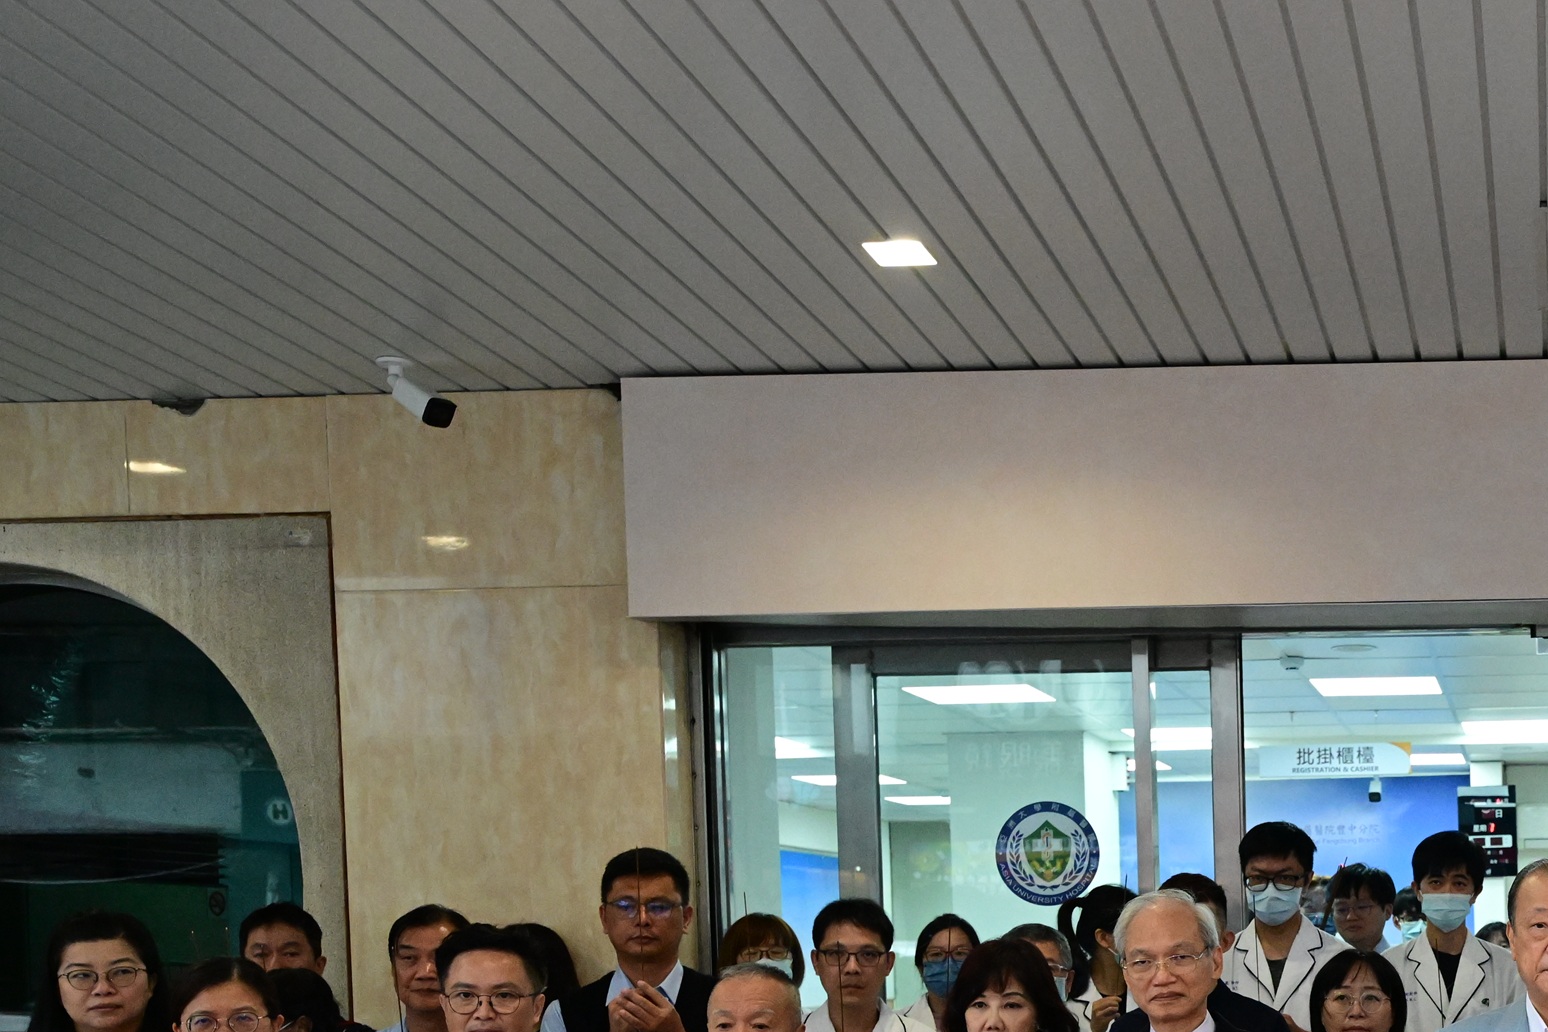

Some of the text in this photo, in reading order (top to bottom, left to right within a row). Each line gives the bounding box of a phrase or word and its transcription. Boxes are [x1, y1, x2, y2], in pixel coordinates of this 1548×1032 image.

[1292, 766, 1341, 774] REGISTRATION
[999, 863, 1097, 904] ASIA UNIVERSITY HOSPITAL
